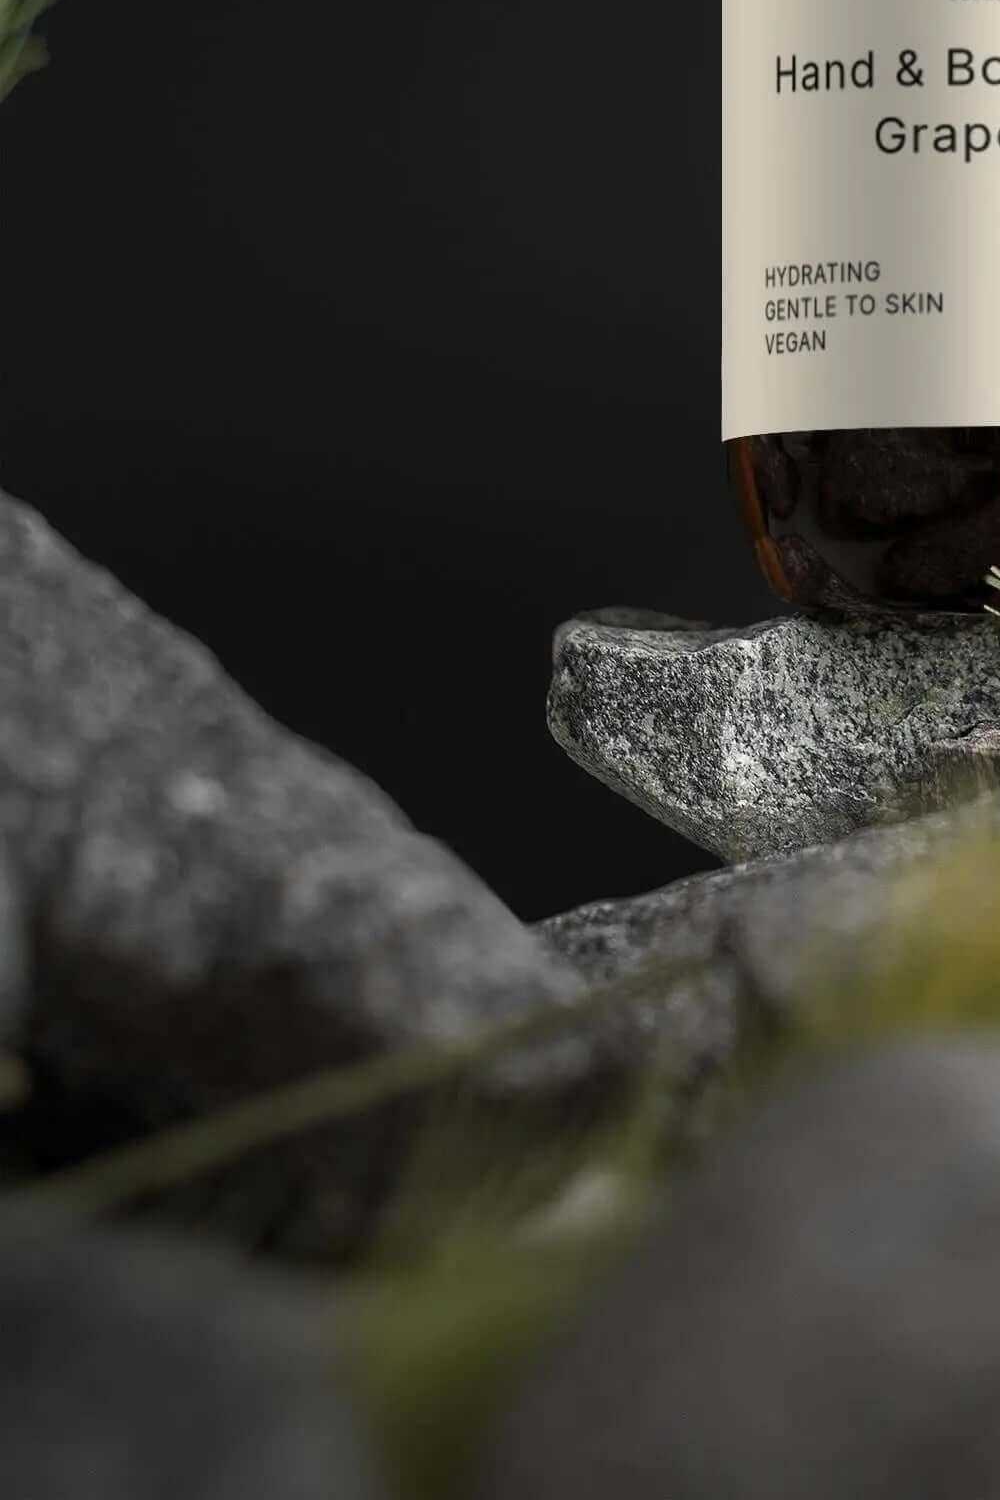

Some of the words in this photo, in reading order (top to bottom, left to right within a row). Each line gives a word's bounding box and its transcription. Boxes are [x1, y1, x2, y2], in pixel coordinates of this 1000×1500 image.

[774, 50, 875, 93] Hand
[895, 48, 924, 88] &
[764, 260, 881, 288] HYDRATING
[764, 296, 837, 321] GENTLE
[845, 293, 876, 317] TO
[885, 292, 944, 315] SKIN
[764, 329, 827, 355] VEGAN
